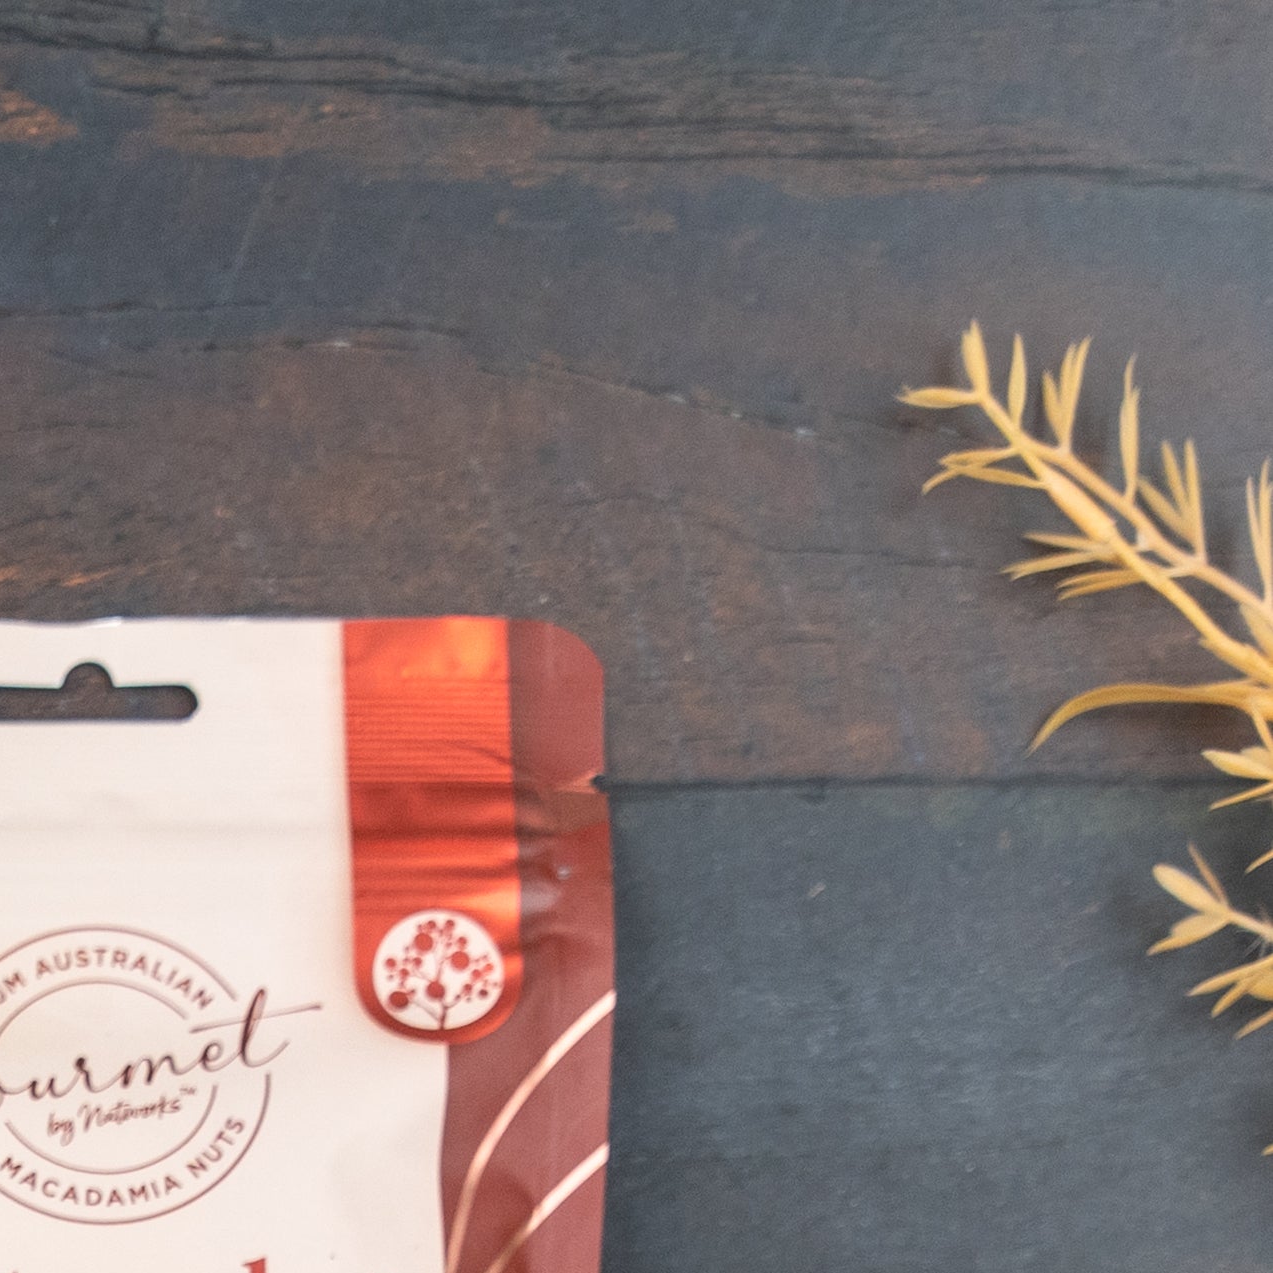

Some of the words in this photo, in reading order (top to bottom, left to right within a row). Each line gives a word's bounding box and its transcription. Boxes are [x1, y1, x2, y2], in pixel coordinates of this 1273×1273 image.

[35, 948, 216, 1010] AUSTRALIAN
[47, 1113, 75, 1146] by
[0, 1156, 183, 1207] MACADAMIA
[186, 1116, 246, 1178] NUTS
